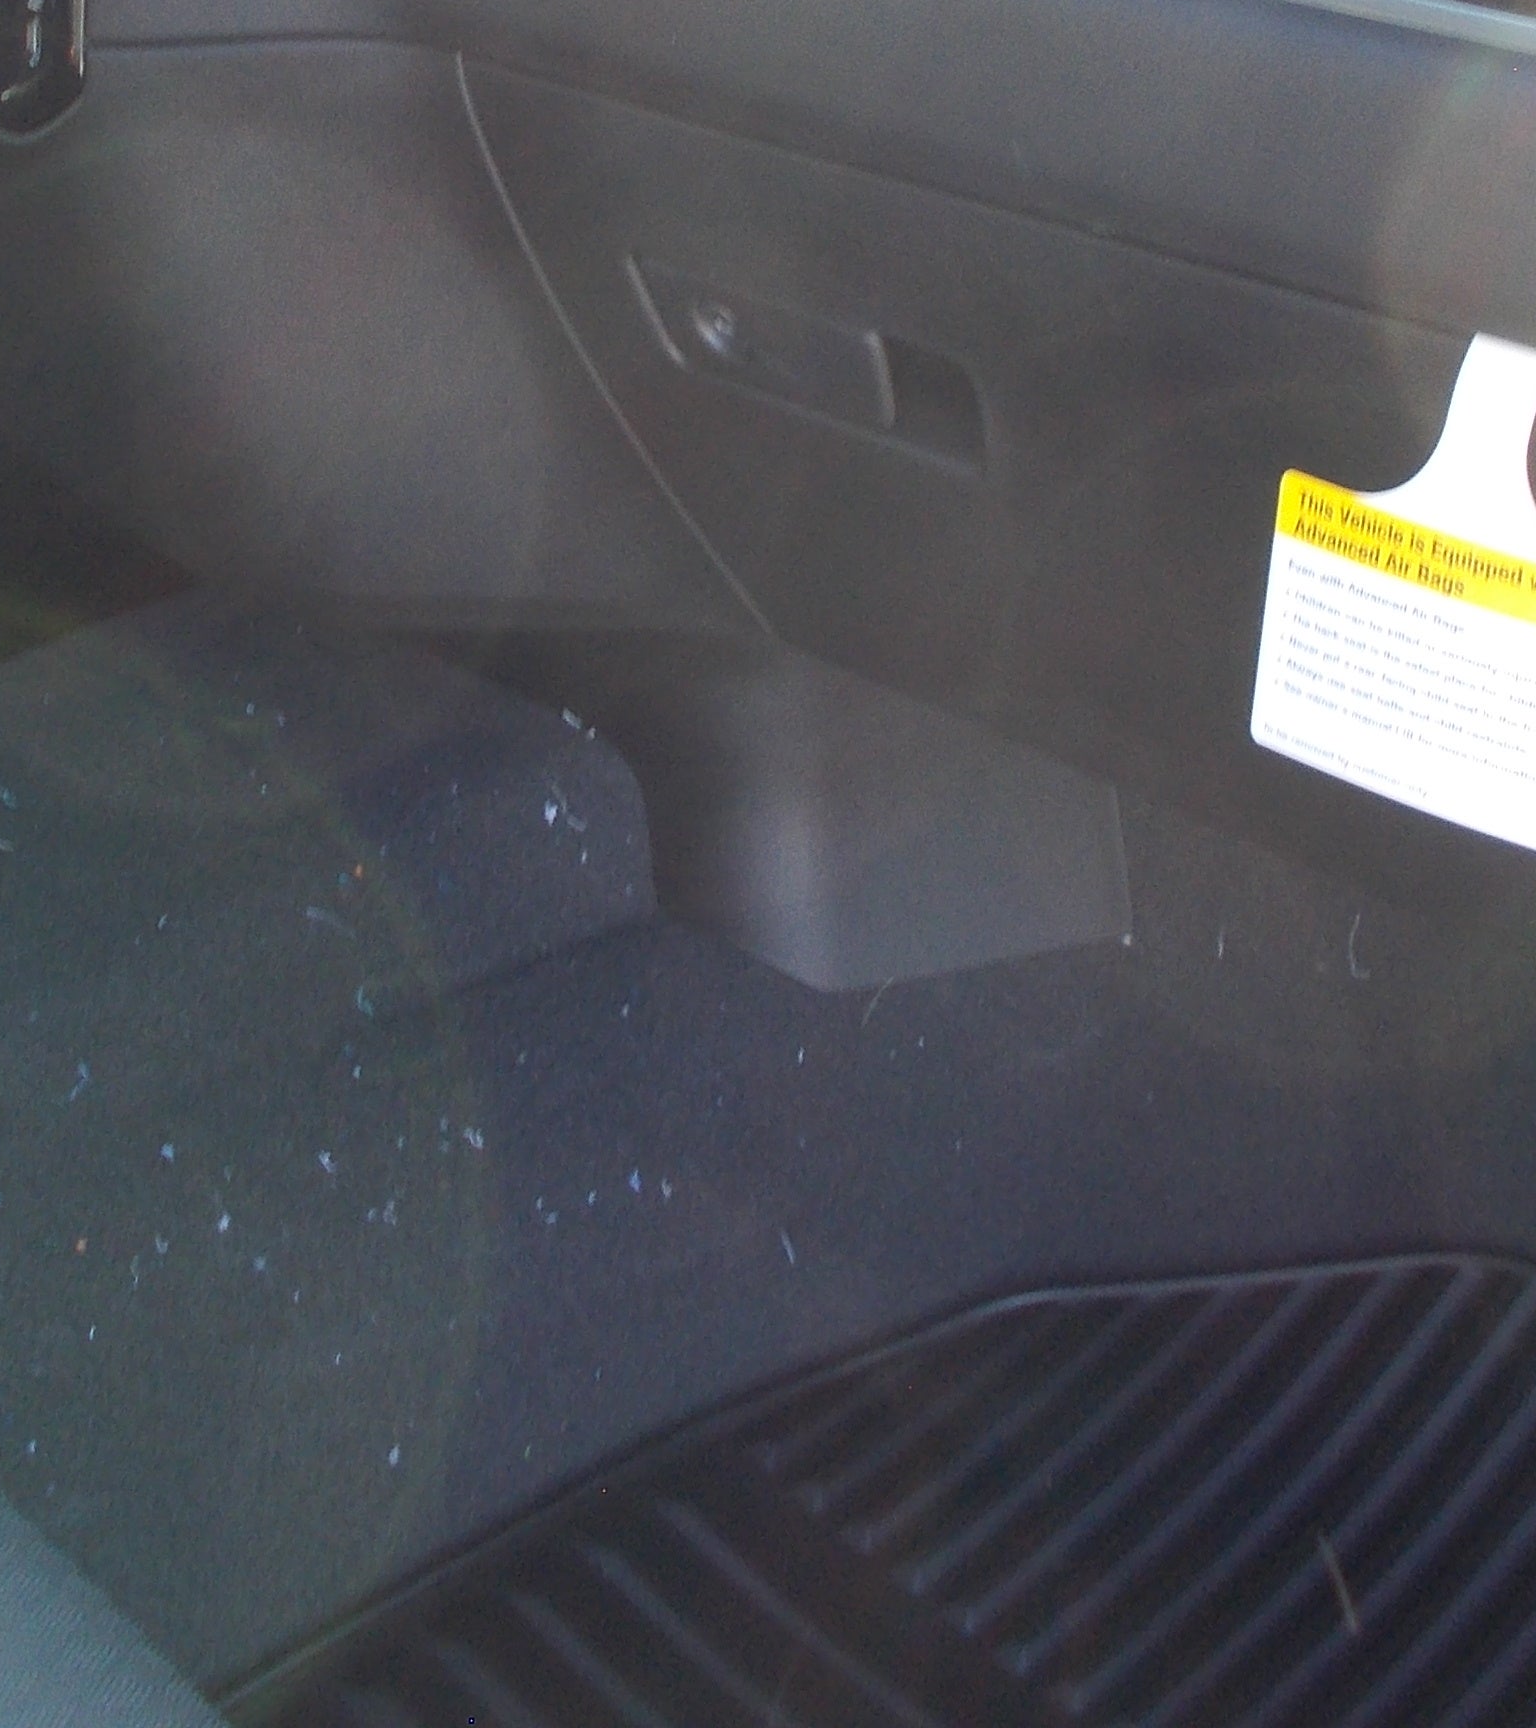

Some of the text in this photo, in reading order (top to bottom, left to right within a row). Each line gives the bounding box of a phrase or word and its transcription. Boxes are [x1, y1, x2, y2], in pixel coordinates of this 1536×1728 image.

[1293, 517, 1465, 595] Advanced Air Bags
[1300, 492, 1334, 521] This
[1340, 506, 1404, 544] Vehicle
[1409, 531, 1425, 554] is
[1430, 539, 1523, 585] Equipped
